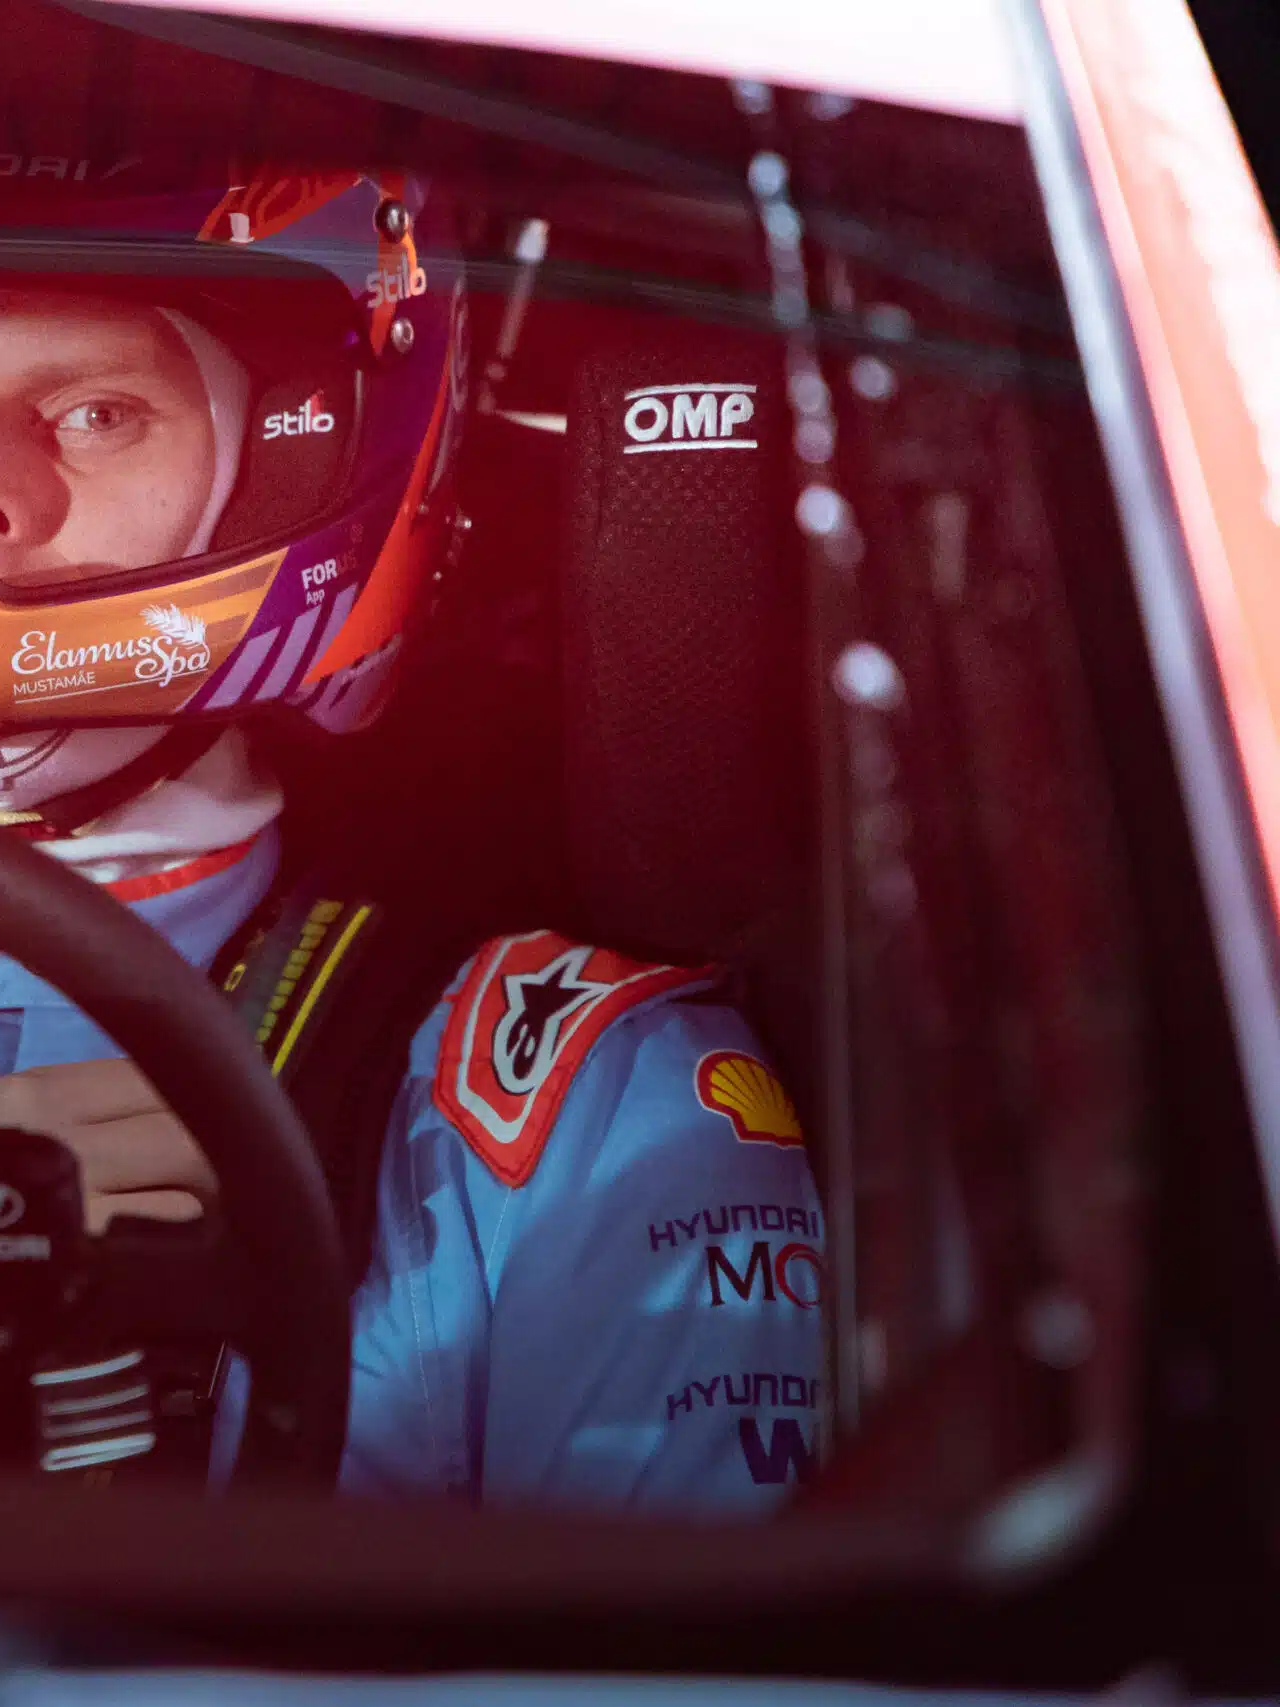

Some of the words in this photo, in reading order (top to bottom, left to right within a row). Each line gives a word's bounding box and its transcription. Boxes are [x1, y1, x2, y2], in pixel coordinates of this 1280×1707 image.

[366, 251, 427, 310] stilo
[263, 410, 334, 440] stilo
[623, 392, 755, 442] OMP
[11, 630, 151, 675] Elamus
[135, 635, 210, 688] Spa
[649, 1204, 819, 1252] HYUNDAI
